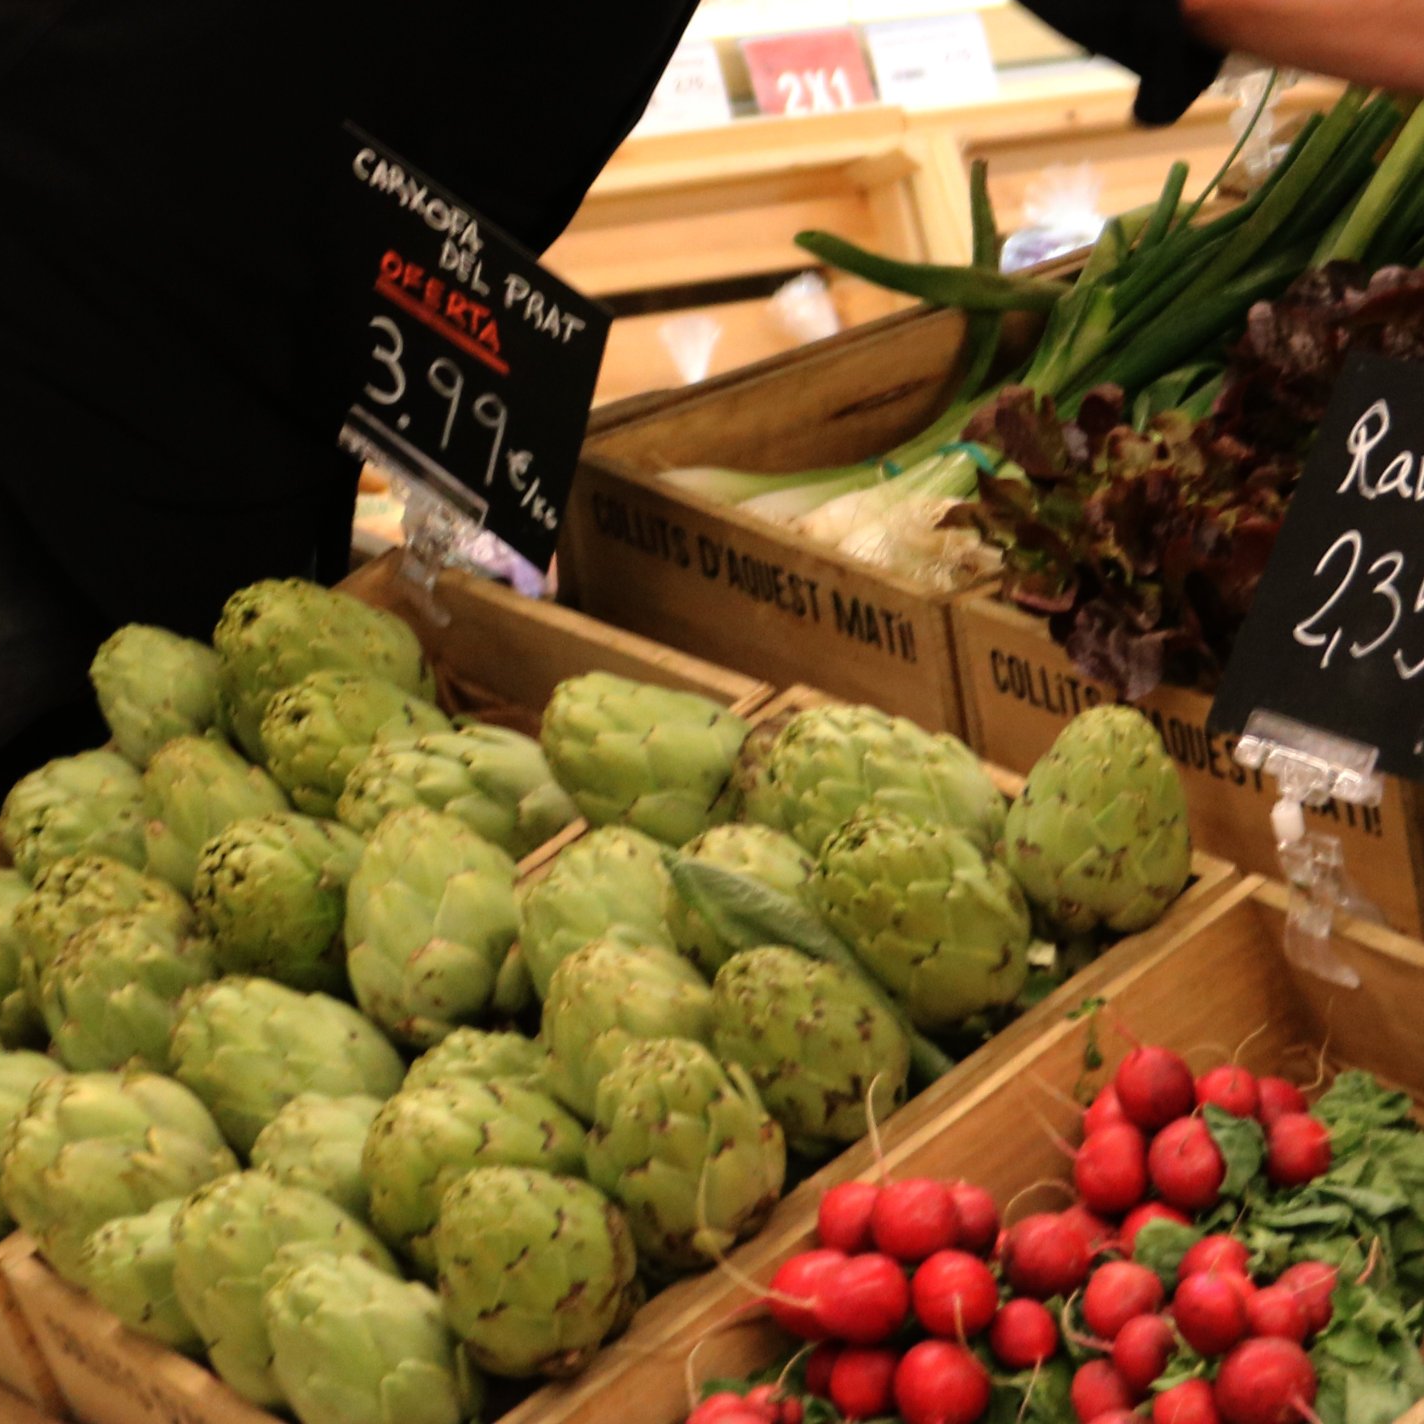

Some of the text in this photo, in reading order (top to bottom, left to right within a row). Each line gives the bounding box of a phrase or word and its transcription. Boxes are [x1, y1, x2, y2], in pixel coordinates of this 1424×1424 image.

[352, 147, 484, 253] CARXOFA
[379, 249, 502, 355] OFERTA
[438, 238, 587, 344] DEL PRAT
